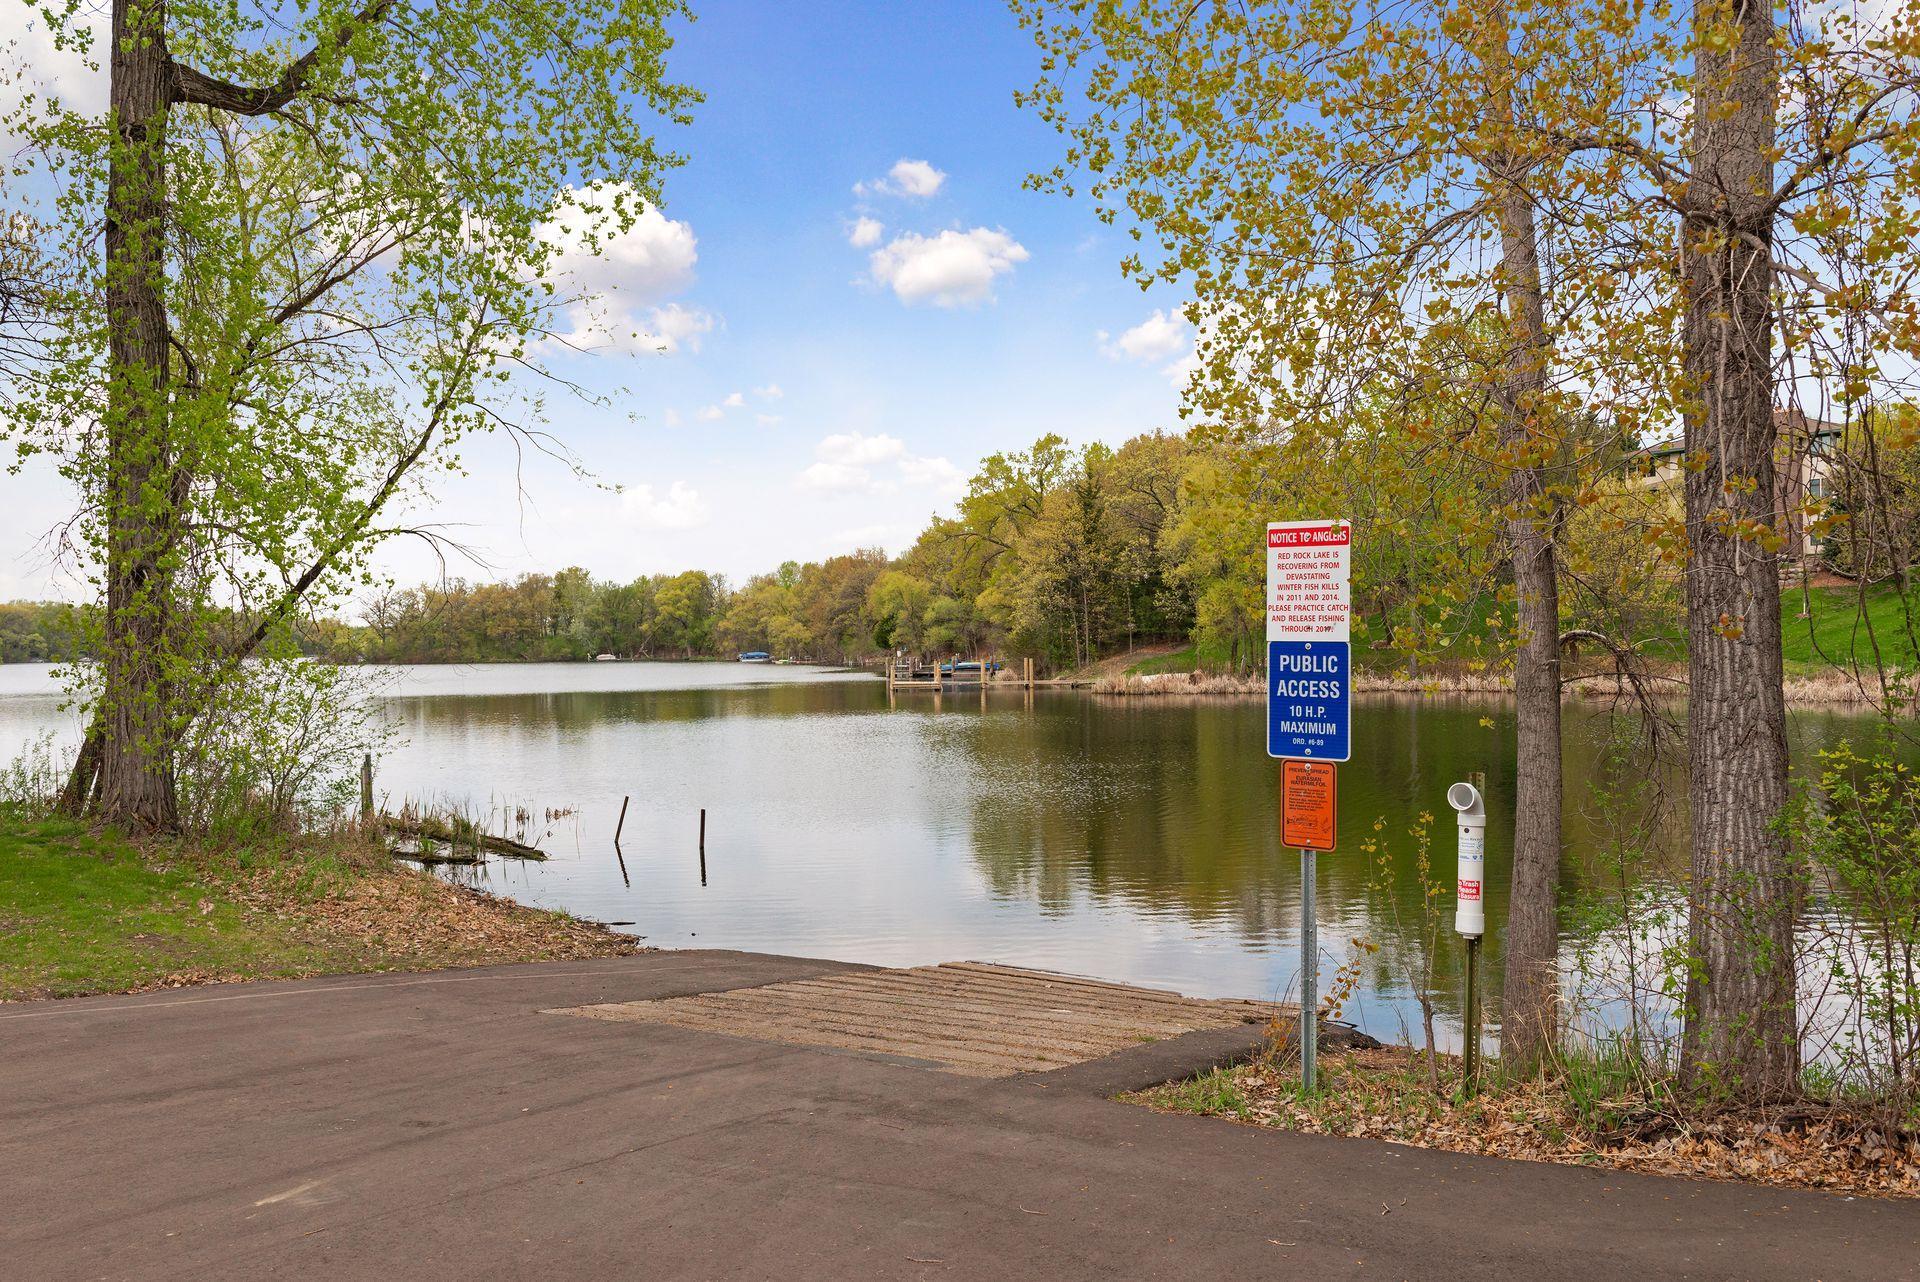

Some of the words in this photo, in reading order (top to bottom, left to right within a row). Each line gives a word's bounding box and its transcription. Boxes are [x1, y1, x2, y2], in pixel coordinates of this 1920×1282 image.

[1270, 532, 1297, 543] NOTICE
[1300, 532, 1311, 542] TO
[1312, 531, 1347, 542] ANGLERS
[1280, 654, 1338, 673] PUBLIC
[1277, 680, 1340, 698] ACCESS
[1290, 705, 1302, 717] 10
[1306, 706, 1327, 718] H.P.
[1280, 721, 1336, 735] MAXIMUM
